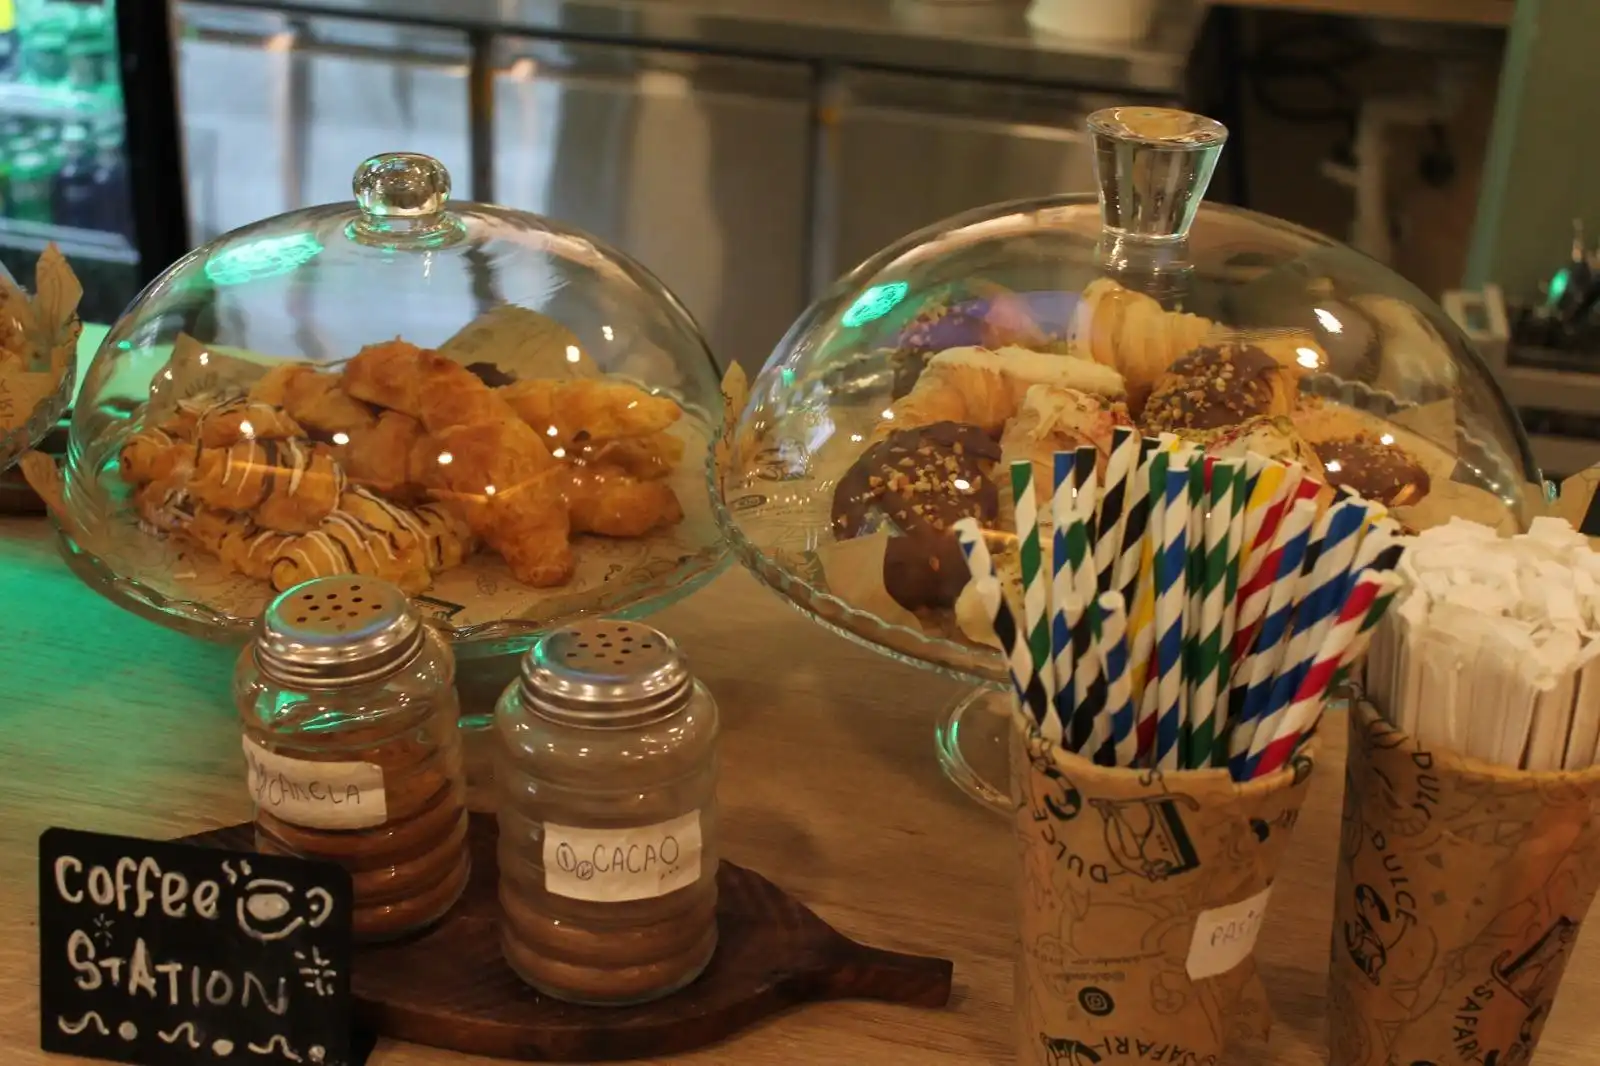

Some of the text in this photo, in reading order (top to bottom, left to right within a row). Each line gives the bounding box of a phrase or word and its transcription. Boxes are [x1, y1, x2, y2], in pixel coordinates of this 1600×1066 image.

[1032, 807, 1108, 884] DULCE
[54, 856, 219, 918] Coffee
[67, 929, 287, 1014] STATION
